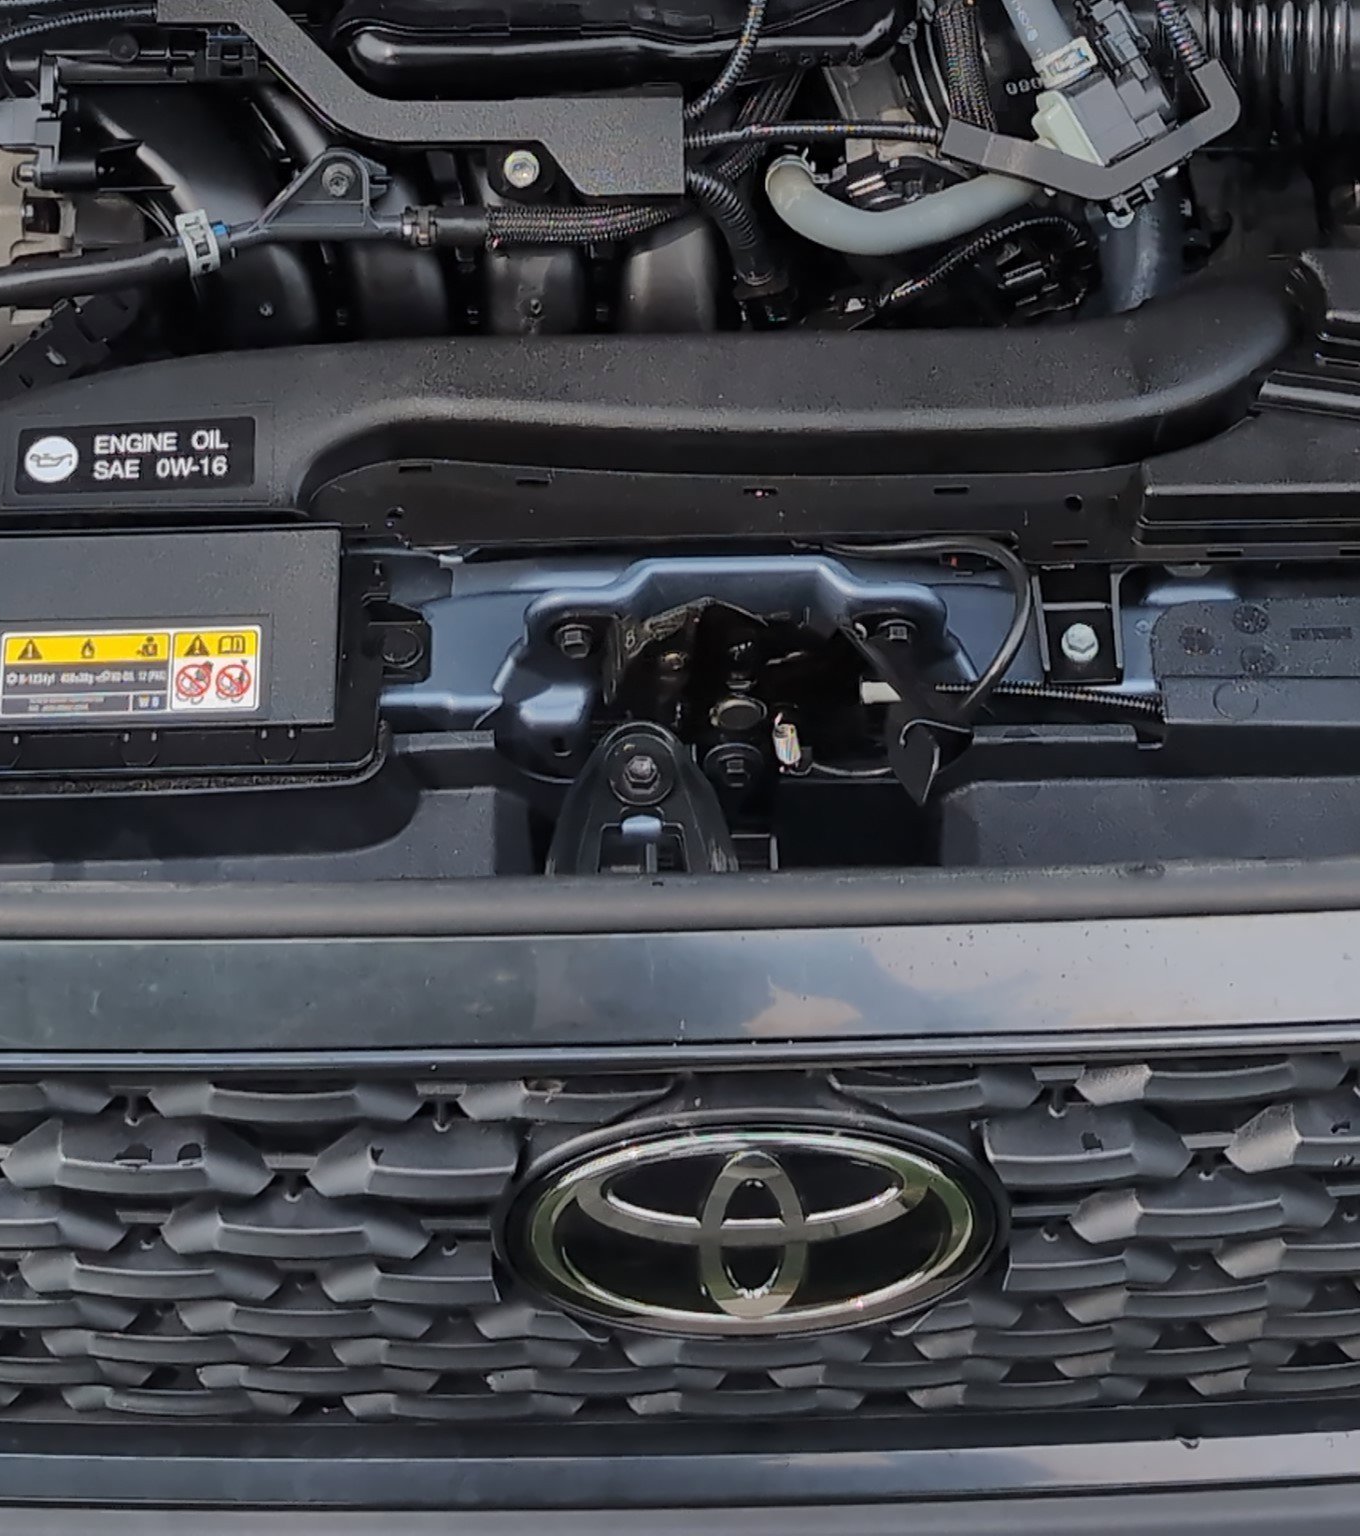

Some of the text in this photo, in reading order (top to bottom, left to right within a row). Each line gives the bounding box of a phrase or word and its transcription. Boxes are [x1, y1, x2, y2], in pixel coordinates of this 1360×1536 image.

[93, 429, 229, 455] ENGINE OIL
[93, 455, 228, 481] SAE 0W-16
